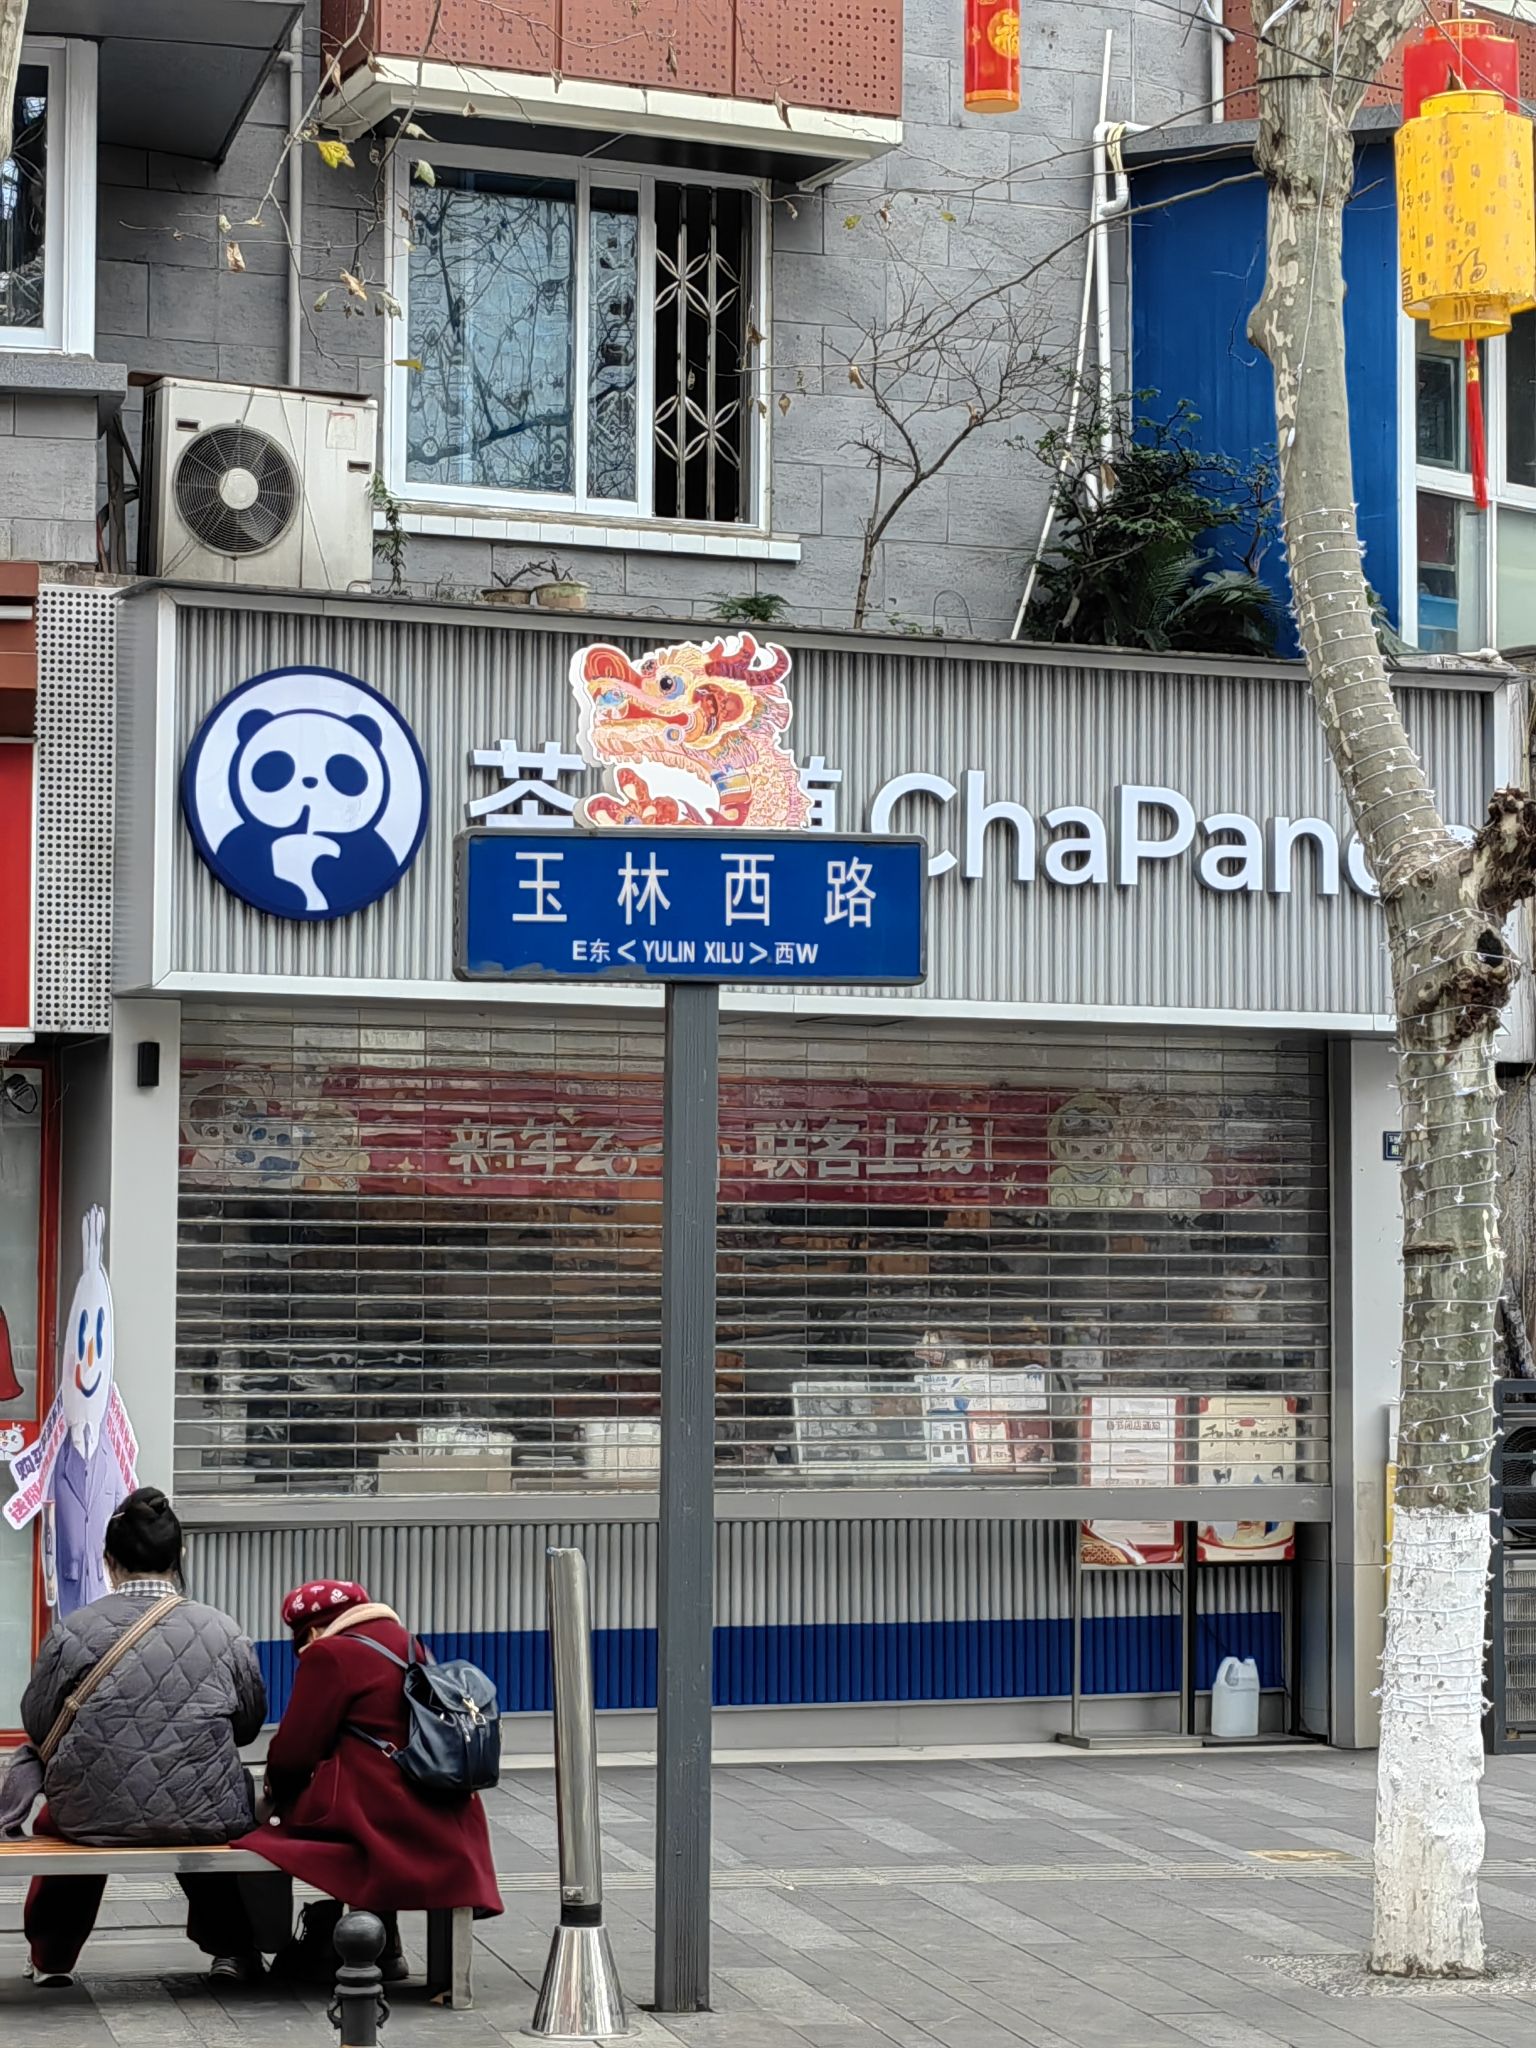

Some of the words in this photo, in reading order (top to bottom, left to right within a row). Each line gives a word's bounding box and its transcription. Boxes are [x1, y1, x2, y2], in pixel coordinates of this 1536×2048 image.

[869, 768, 1479, 899] ChaPan
[511, 850, 877, 930] 玉林西路
[643, 940, 696, 964] YULIN
[703, 941, 744, 965] XILU
